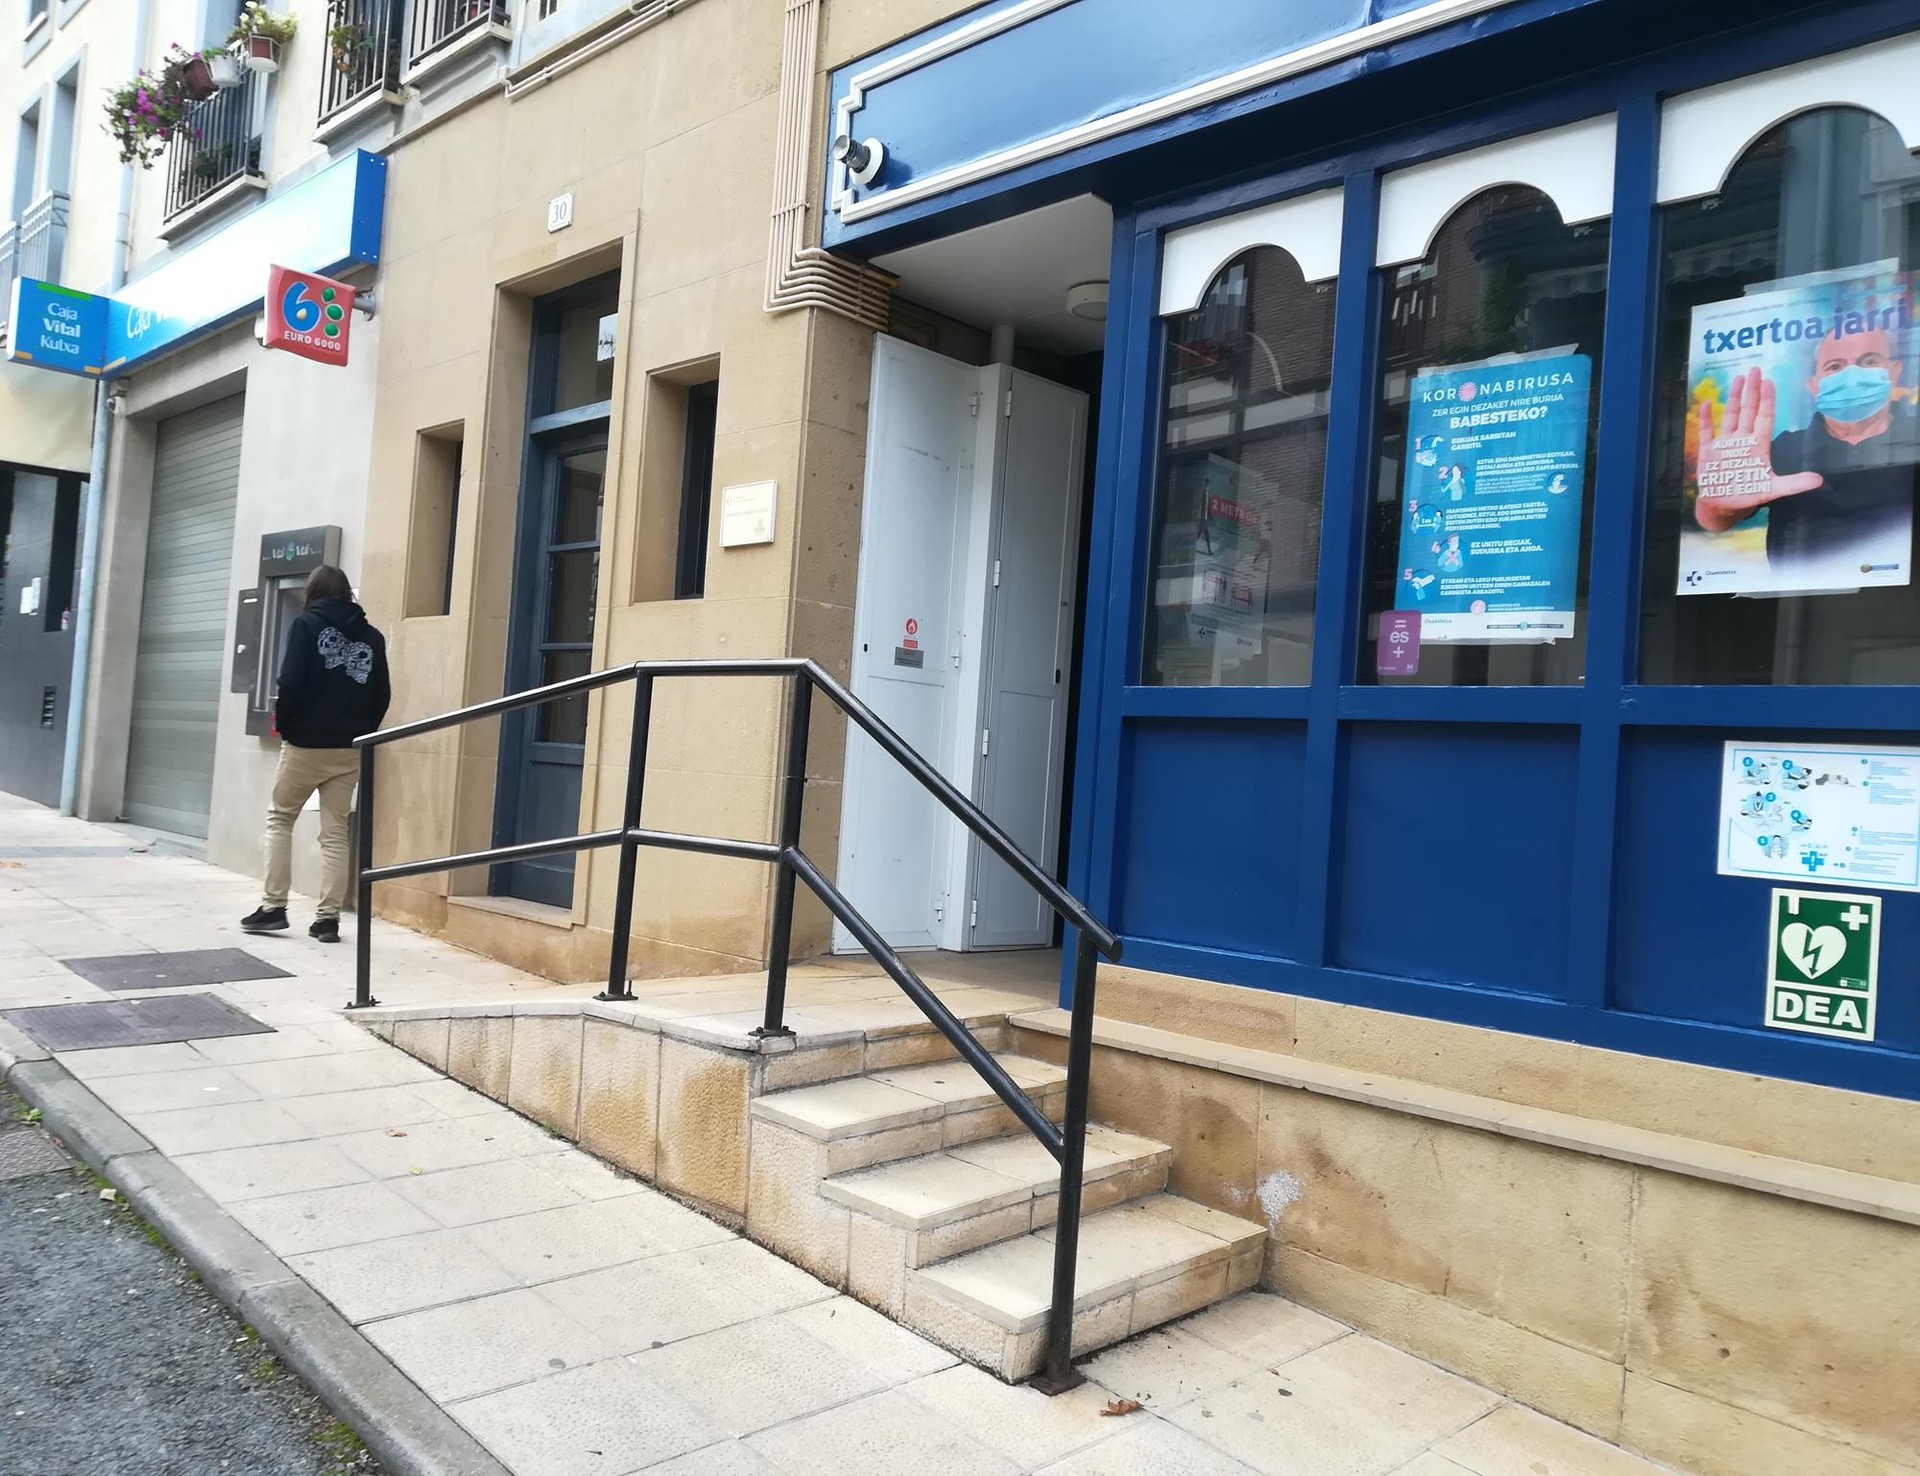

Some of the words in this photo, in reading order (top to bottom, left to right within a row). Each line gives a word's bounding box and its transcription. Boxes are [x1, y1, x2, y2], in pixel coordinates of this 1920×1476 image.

[551, 201, 567, 224] 30
[47, 302, 78, 321] Caja
[43, 317, 81, 338] Vital
[1703, 317, 1824, 355] txertoa
[1834, 298, 1908, 340] jarri
[40, 334, 80, 355] Kutxa
[284, 330, 312, 345] EURO
[314, 337, 342, 351] 6000
[1432, 408, 1449, 417] ZER
[1449, 405, 1469, 415] EGIN
[1470, 400, 1509, 412] DEZAKET
[1510, 397, 1532, 408] NIRE
[1532, 393, 1564, 404] BURUA
[1450, 405, 1548, 429] BABESTEKO?
[1698, 466, 1772, 487] GRIPETIK
[1701, 485, 1734, 498] ALDE
[1389, 631, 1410, 644] es
[1776, 990, 1863, 1029] DEA
